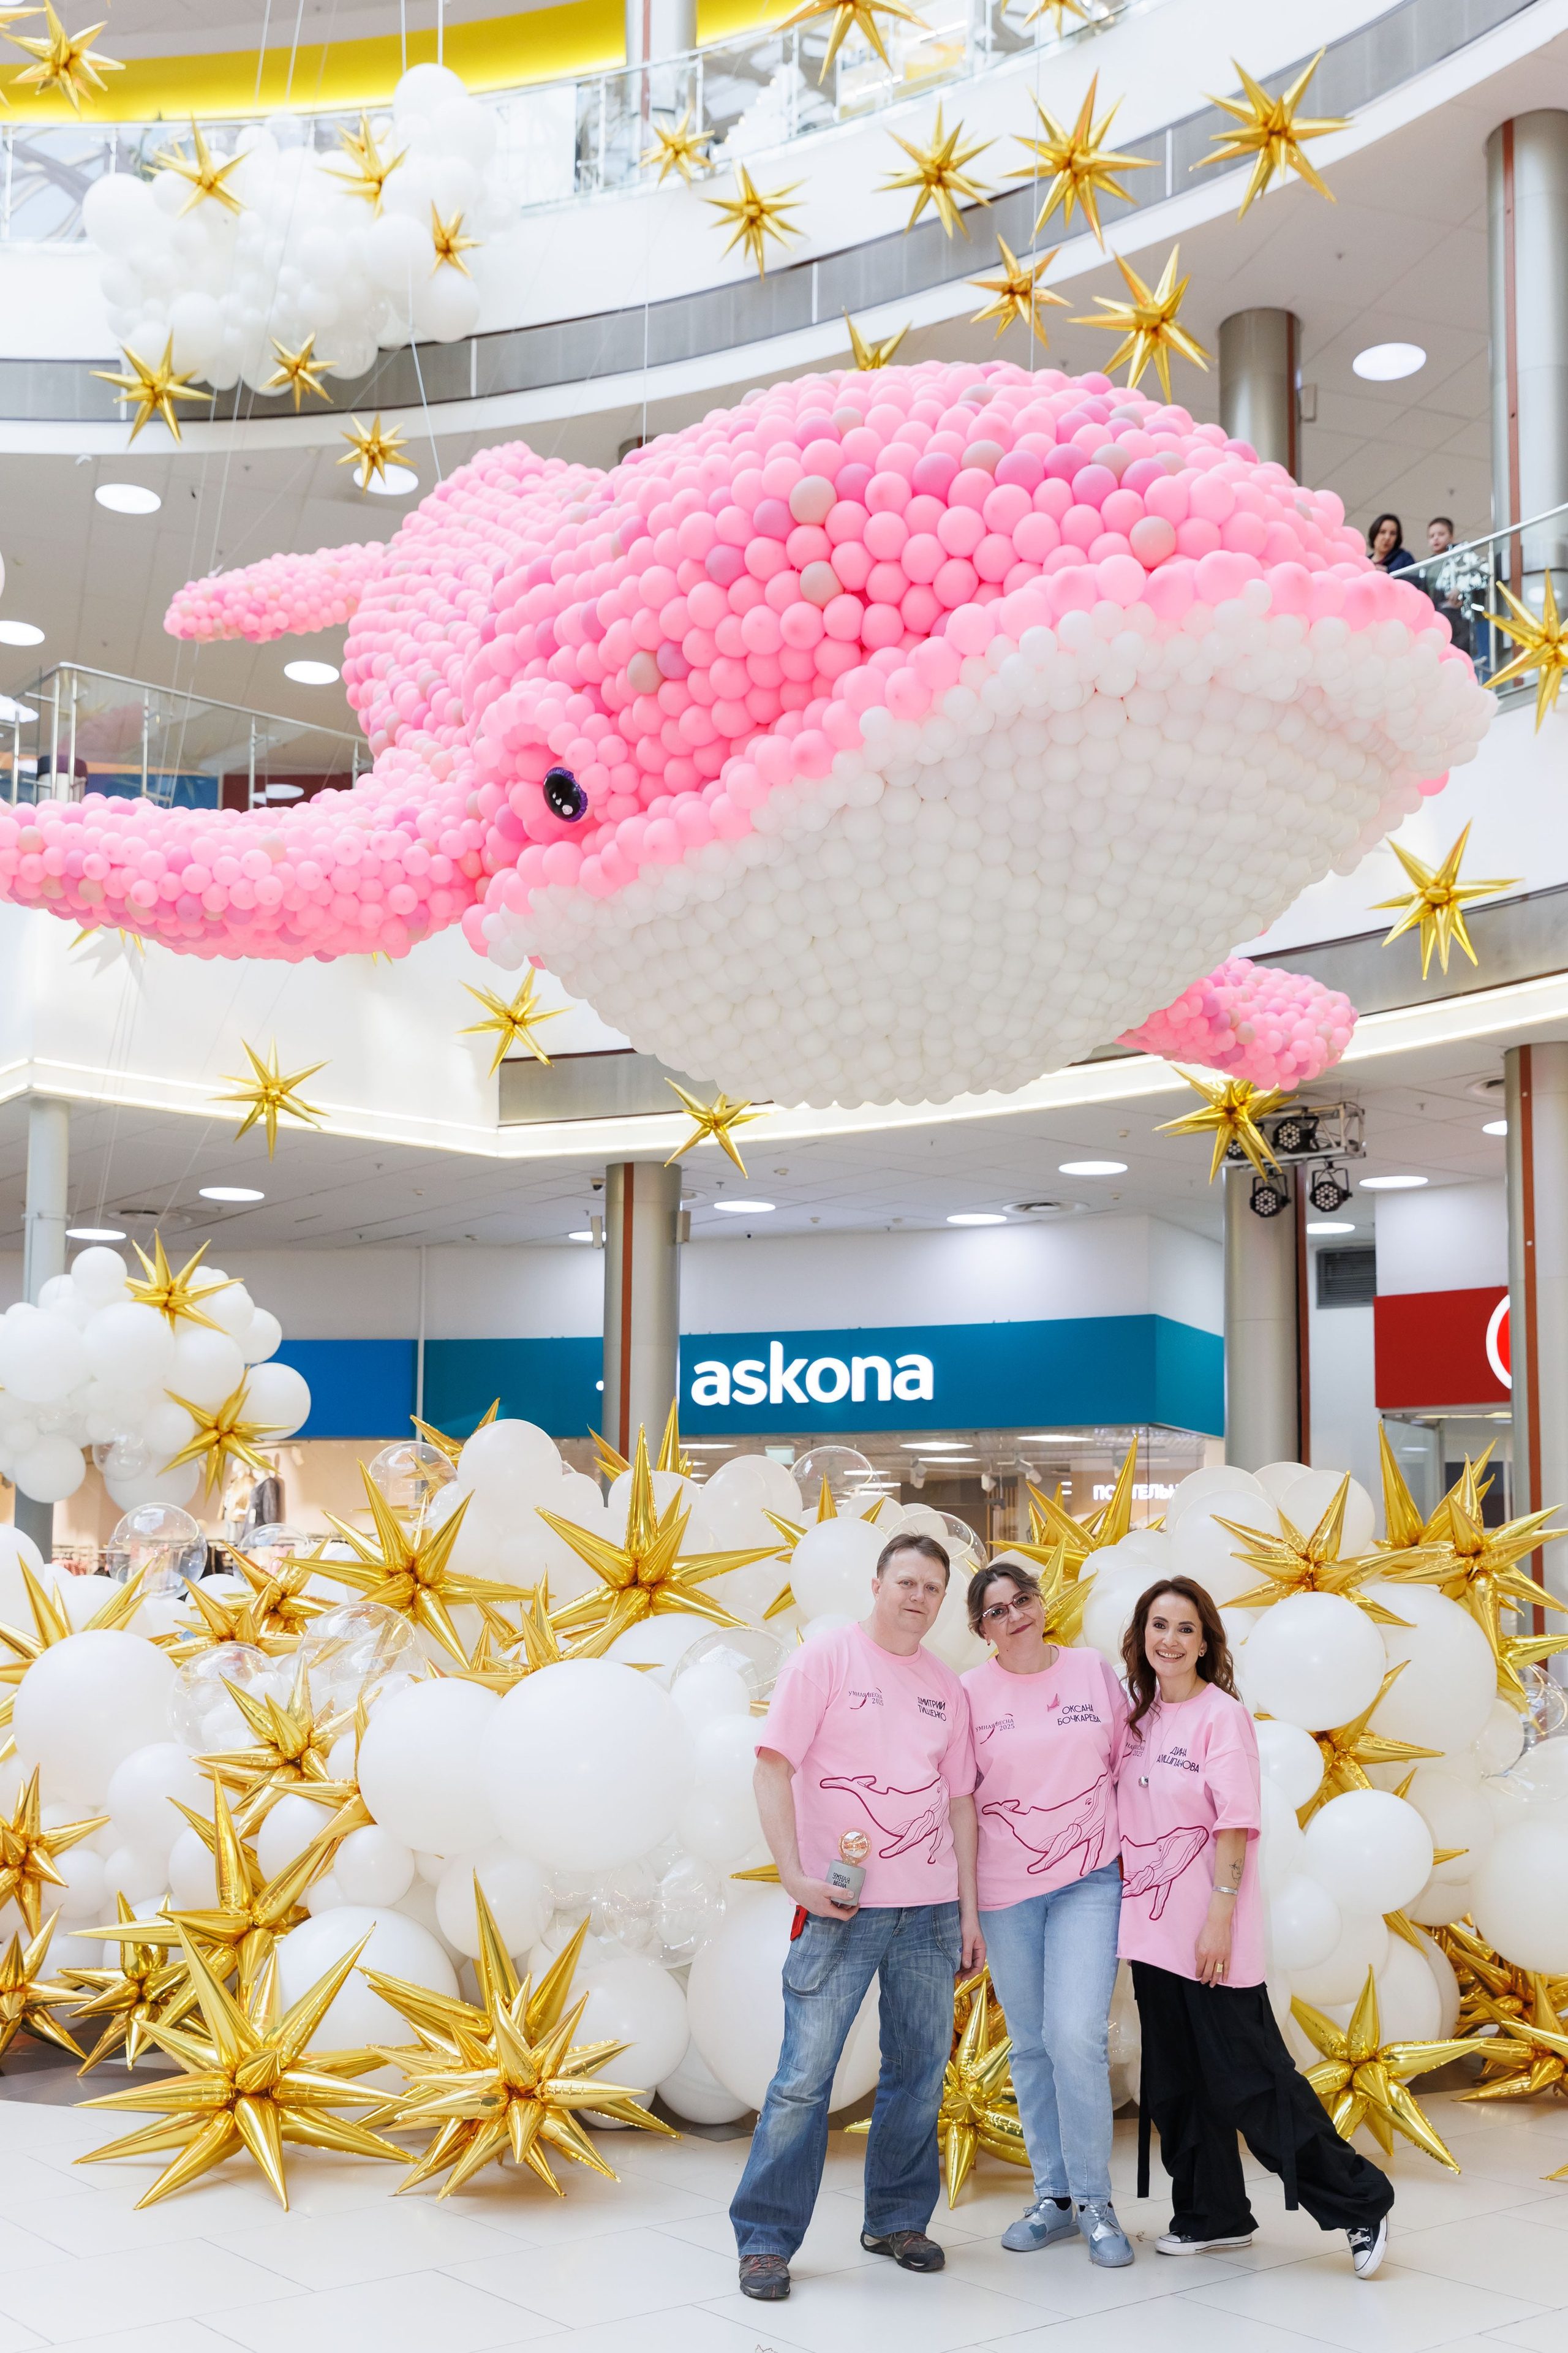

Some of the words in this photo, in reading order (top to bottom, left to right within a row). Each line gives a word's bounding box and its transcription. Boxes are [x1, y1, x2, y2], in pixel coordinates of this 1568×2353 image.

[691, 1340, 934, 1406] askona
[872, 1698, 884, 1706] 2025
[917, 1696, 946, 1710] ДМИТРИЙ
[918, 1704, 947, 1721] ТИЩЕНКО
[1061, 1704, 1094, 1715] ОКСАНА
[1057, 1713, 1102, 1726] БОЧКАРЕВА
[975, 1724, 995, 1732] УМНАЯ
[1169, 1746, 1187, 1757] ДИНА
[832, 1872, 851, 1884] УМНАЯ
[832, 1880, 846, 1889] ВЕСНА
